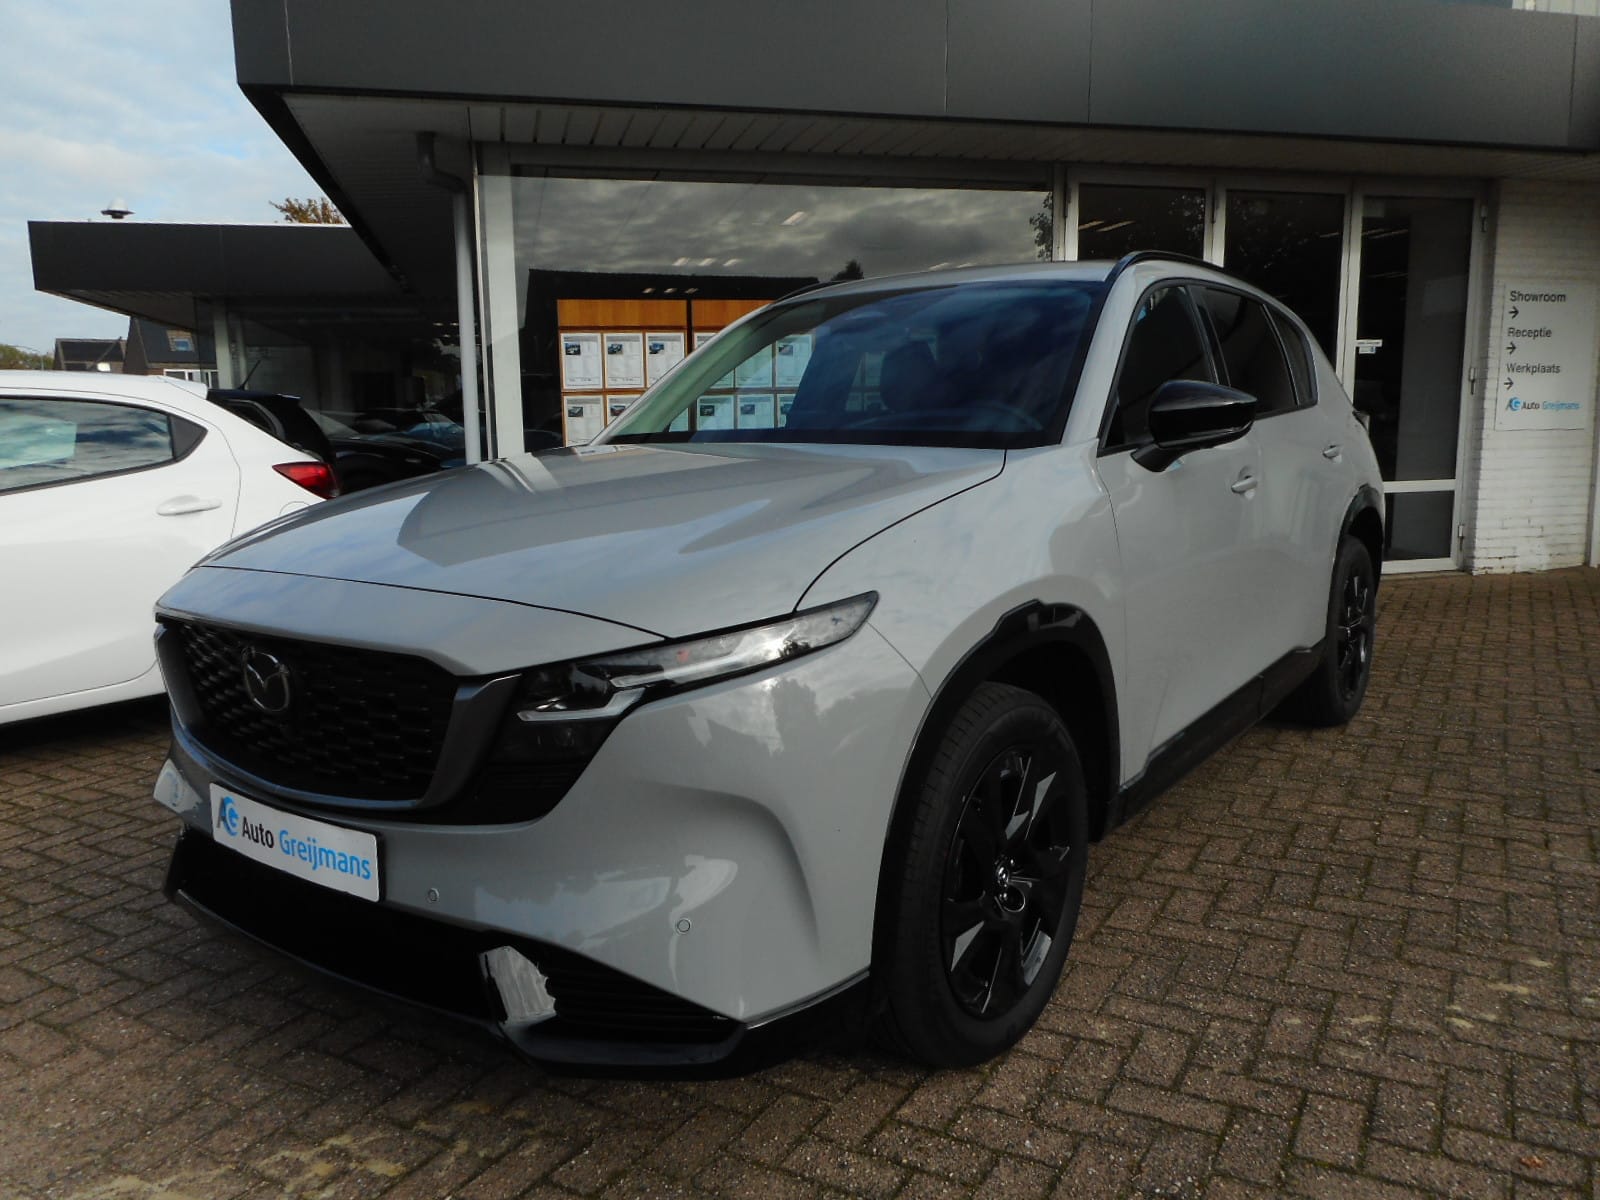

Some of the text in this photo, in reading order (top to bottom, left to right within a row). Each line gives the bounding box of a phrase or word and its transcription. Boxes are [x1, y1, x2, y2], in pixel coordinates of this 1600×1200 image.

[1510, 290, 1567, 302] Showroom
[1507, 327, 1552, 340] Receptie
[1506, 362, 1561, 375] Werkplaats
[1521, 402, 1540, 410] Auto
[242, 816, 275, 848] Auto
[279, 830, 372, 880] Greijmans
